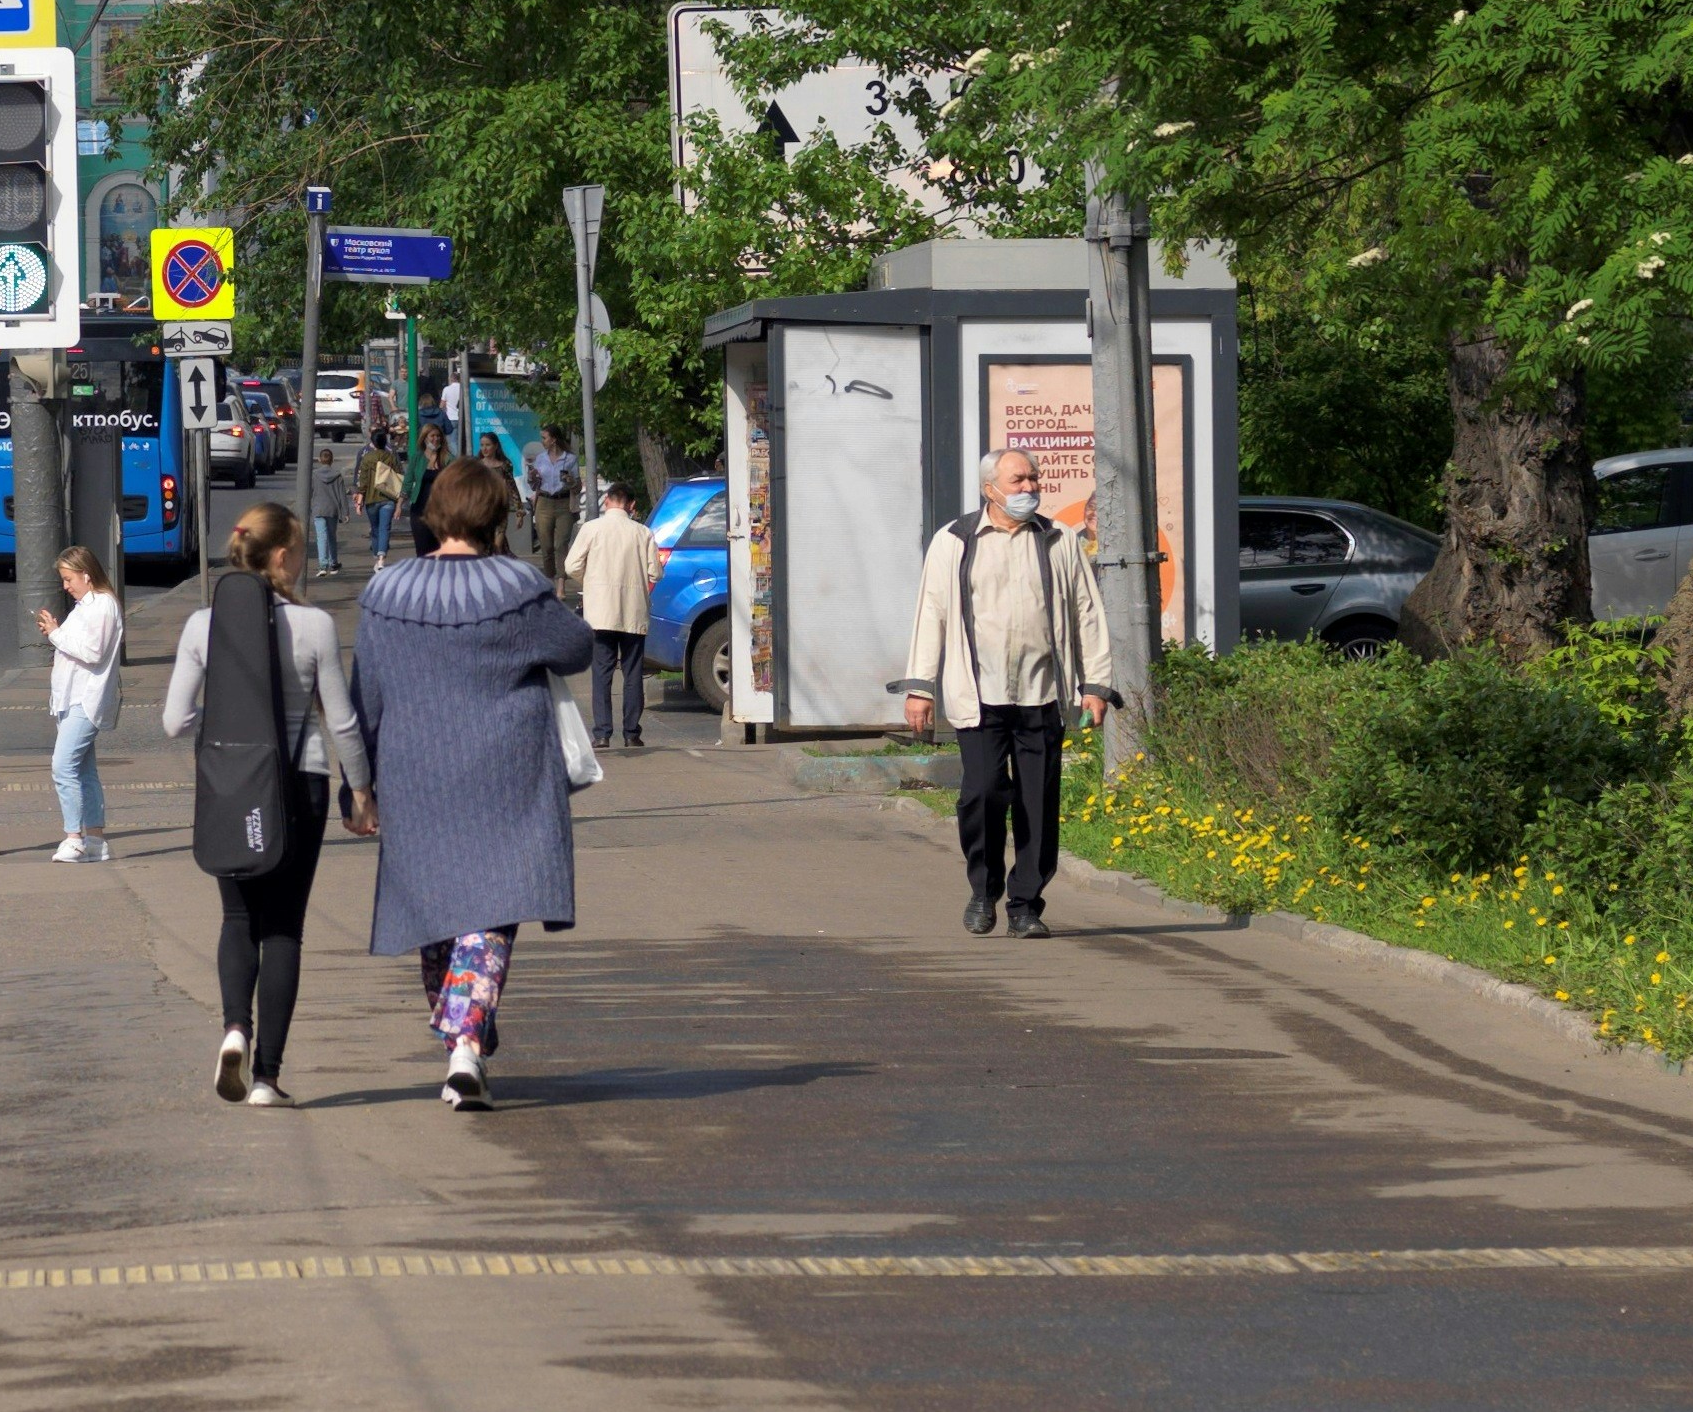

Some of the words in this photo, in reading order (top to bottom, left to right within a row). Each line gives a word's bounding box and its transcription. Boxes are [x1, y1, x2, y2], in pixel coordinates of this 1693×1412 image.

[344, 238, 393, 248] Московский
[343, 246, 366, 254] театр
[475, 401, 487, 411] ОТ
[1005, 405, 1058, 416] ВЕСНА,
[1061, 404, 1094, 417] ДАЧ
[252, 807, 263, 852] LAVAZZA
